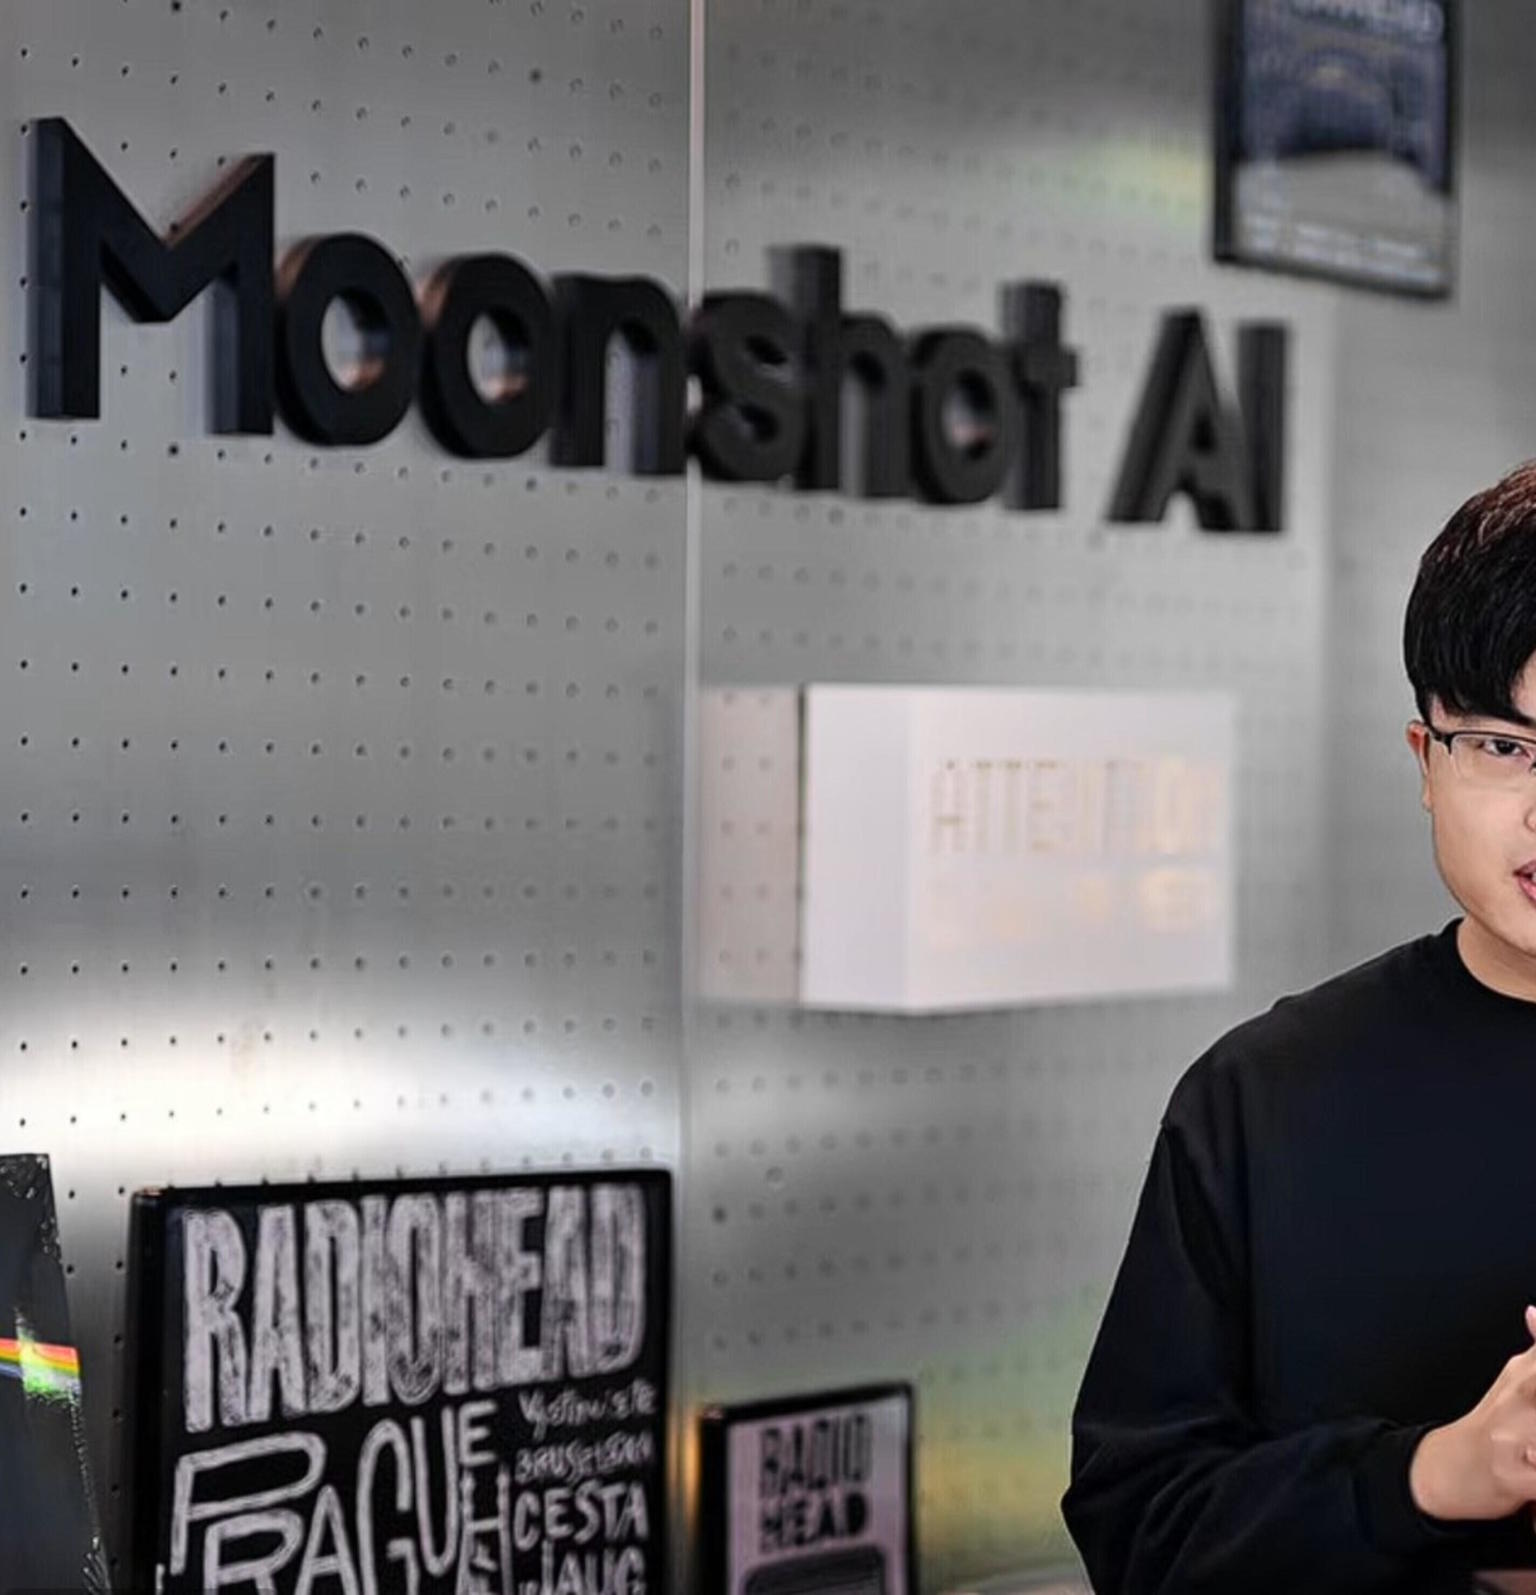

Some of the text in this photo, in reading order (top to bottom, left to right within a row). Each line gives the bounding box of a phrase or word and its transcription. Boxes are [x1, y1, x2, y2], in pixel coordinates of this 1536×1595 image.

[26, 116, 1291, 536] Moonshot AI
[182, 1182, 646, 1434] RADIOHEAD
[169, 1400, 498, 1595] PRAGUE
[513, 1479, 649, 1550] CESTA
[760, 1413, 873, 1502] RADIO
[760, 1491, 869, 1553] HEAD
